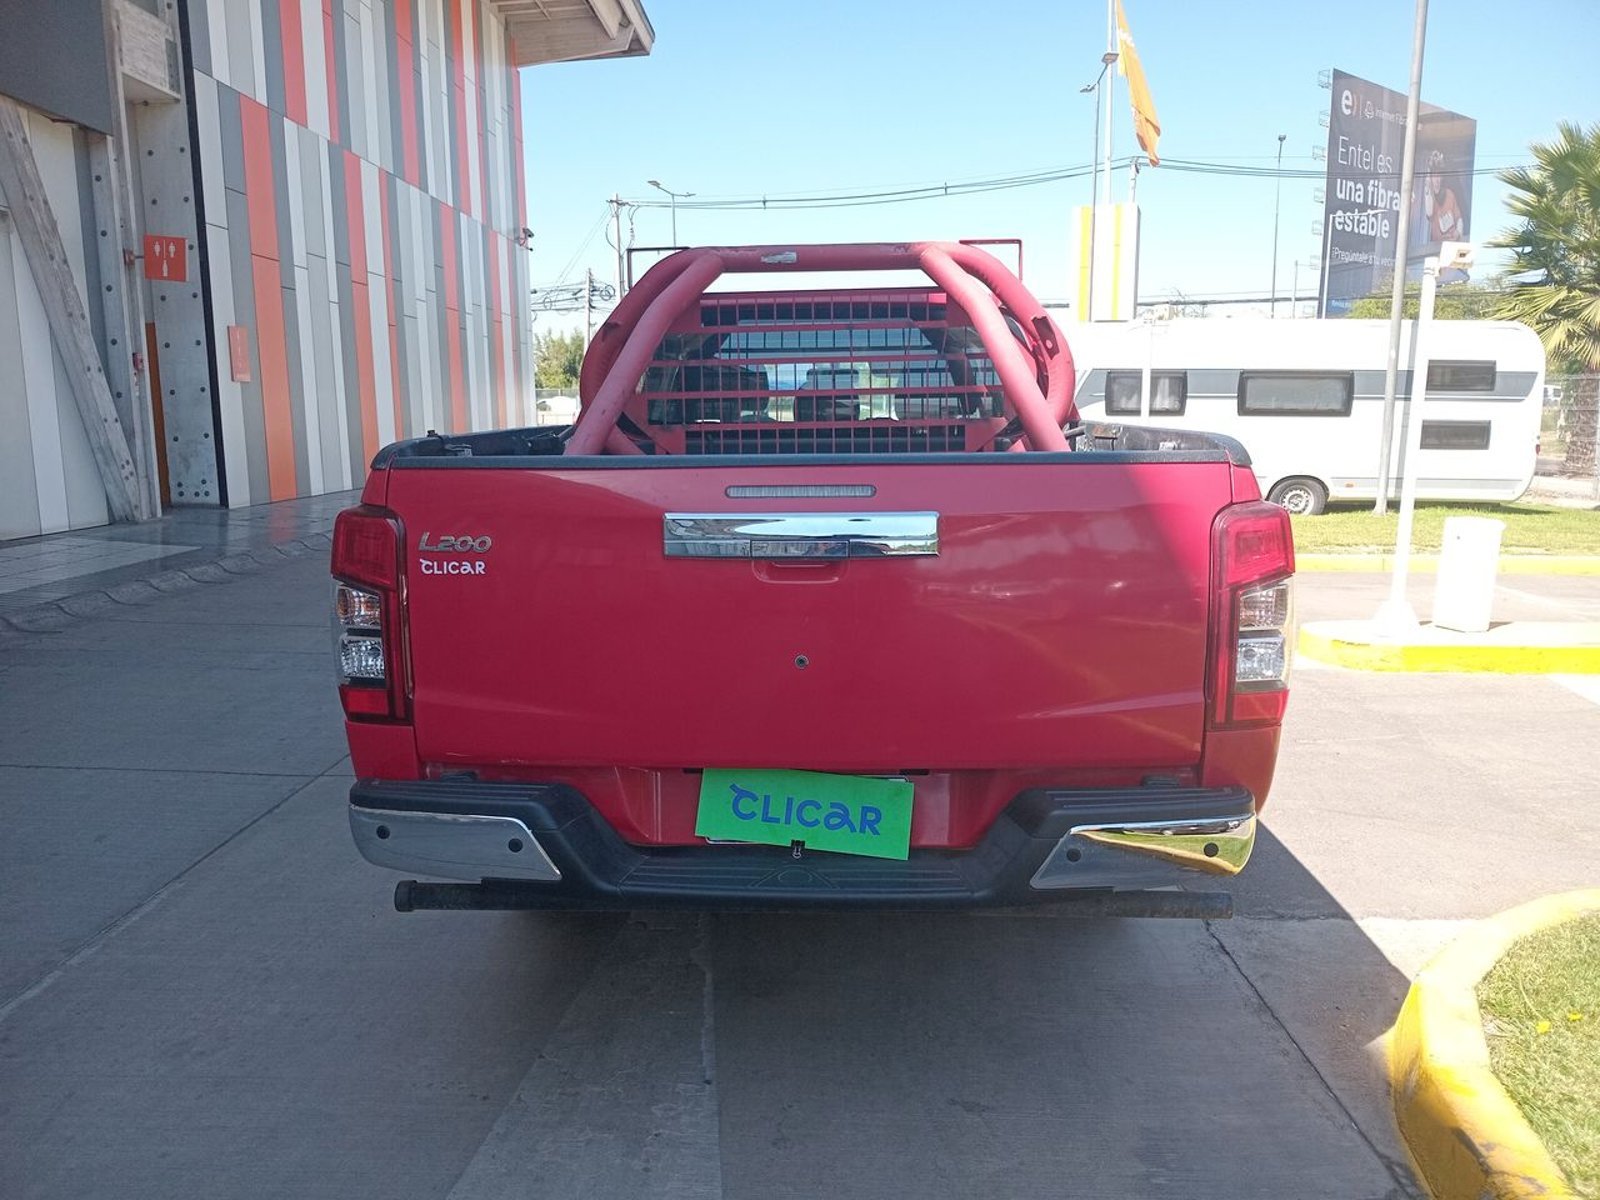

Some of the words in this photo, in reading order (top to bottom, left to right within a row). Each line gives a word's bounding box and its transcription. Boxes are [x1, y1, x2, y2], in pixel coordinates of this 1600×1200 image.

[1338, 135, 1374, 171] Entel
[1377, 154, 1393, 174] es
[1336, 178, 1364, 204] una
[1367, 179, 1401, 211] fibra
[1334, 208, 1390, 239] estable
[418, 531, 492, 553] L200
